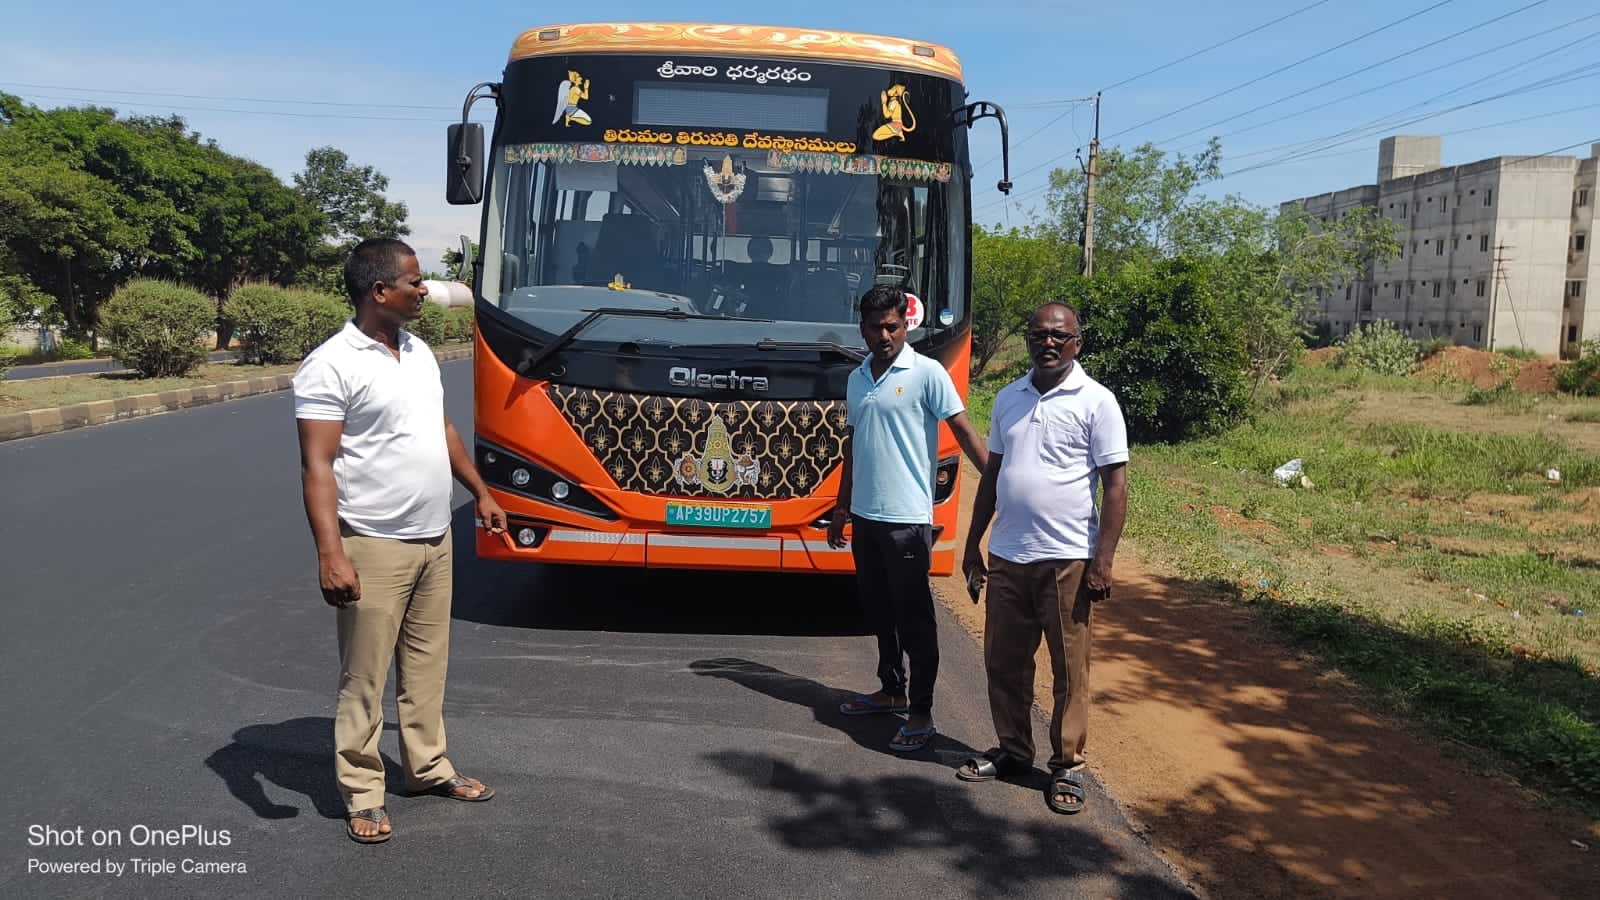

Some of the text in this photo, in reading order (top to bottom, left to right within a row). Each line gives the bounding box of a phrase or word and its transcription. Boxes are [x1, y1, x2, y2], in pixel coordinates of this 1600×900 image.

[656, 61, 812, 84] శ్రీవారి ధర్మరథం
[603, 128, 857, 154] తిరుమల తిరుపతి దేవస్థానములు
[668, 366, 769, 391] Olectra
[675, 505, 768, 524] AP39UP2757
